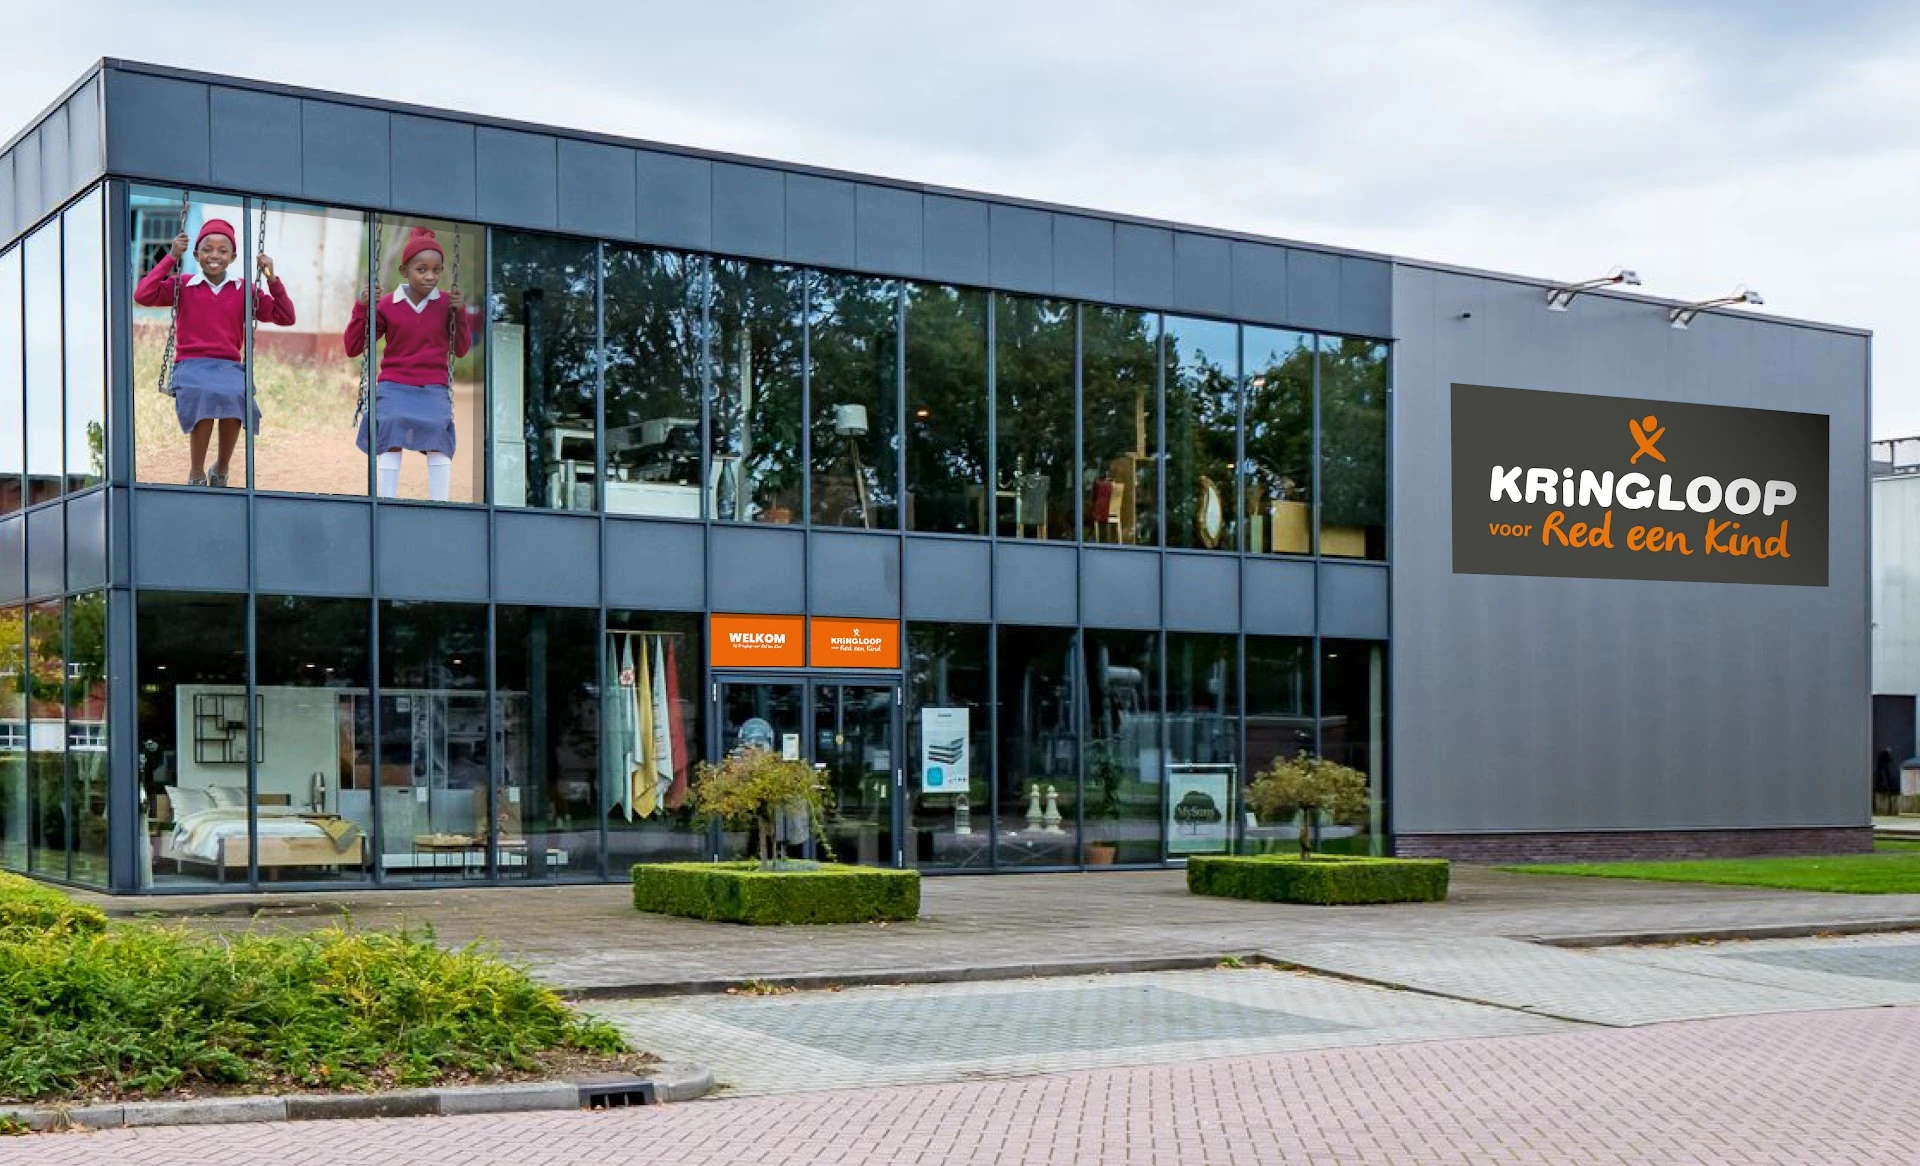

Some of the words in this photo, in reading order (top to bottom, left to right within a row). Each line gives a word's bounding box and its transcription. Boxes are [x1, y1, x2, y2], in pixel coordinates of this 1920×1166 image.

[1489, 522, 1532, 537] voor
[1542, 510, 1614, 549] Red
[1626, 526, 1694, 556] een
[1704, 518, 1791, 559] Kind
[729, 632, 786, 644] WELKOM
